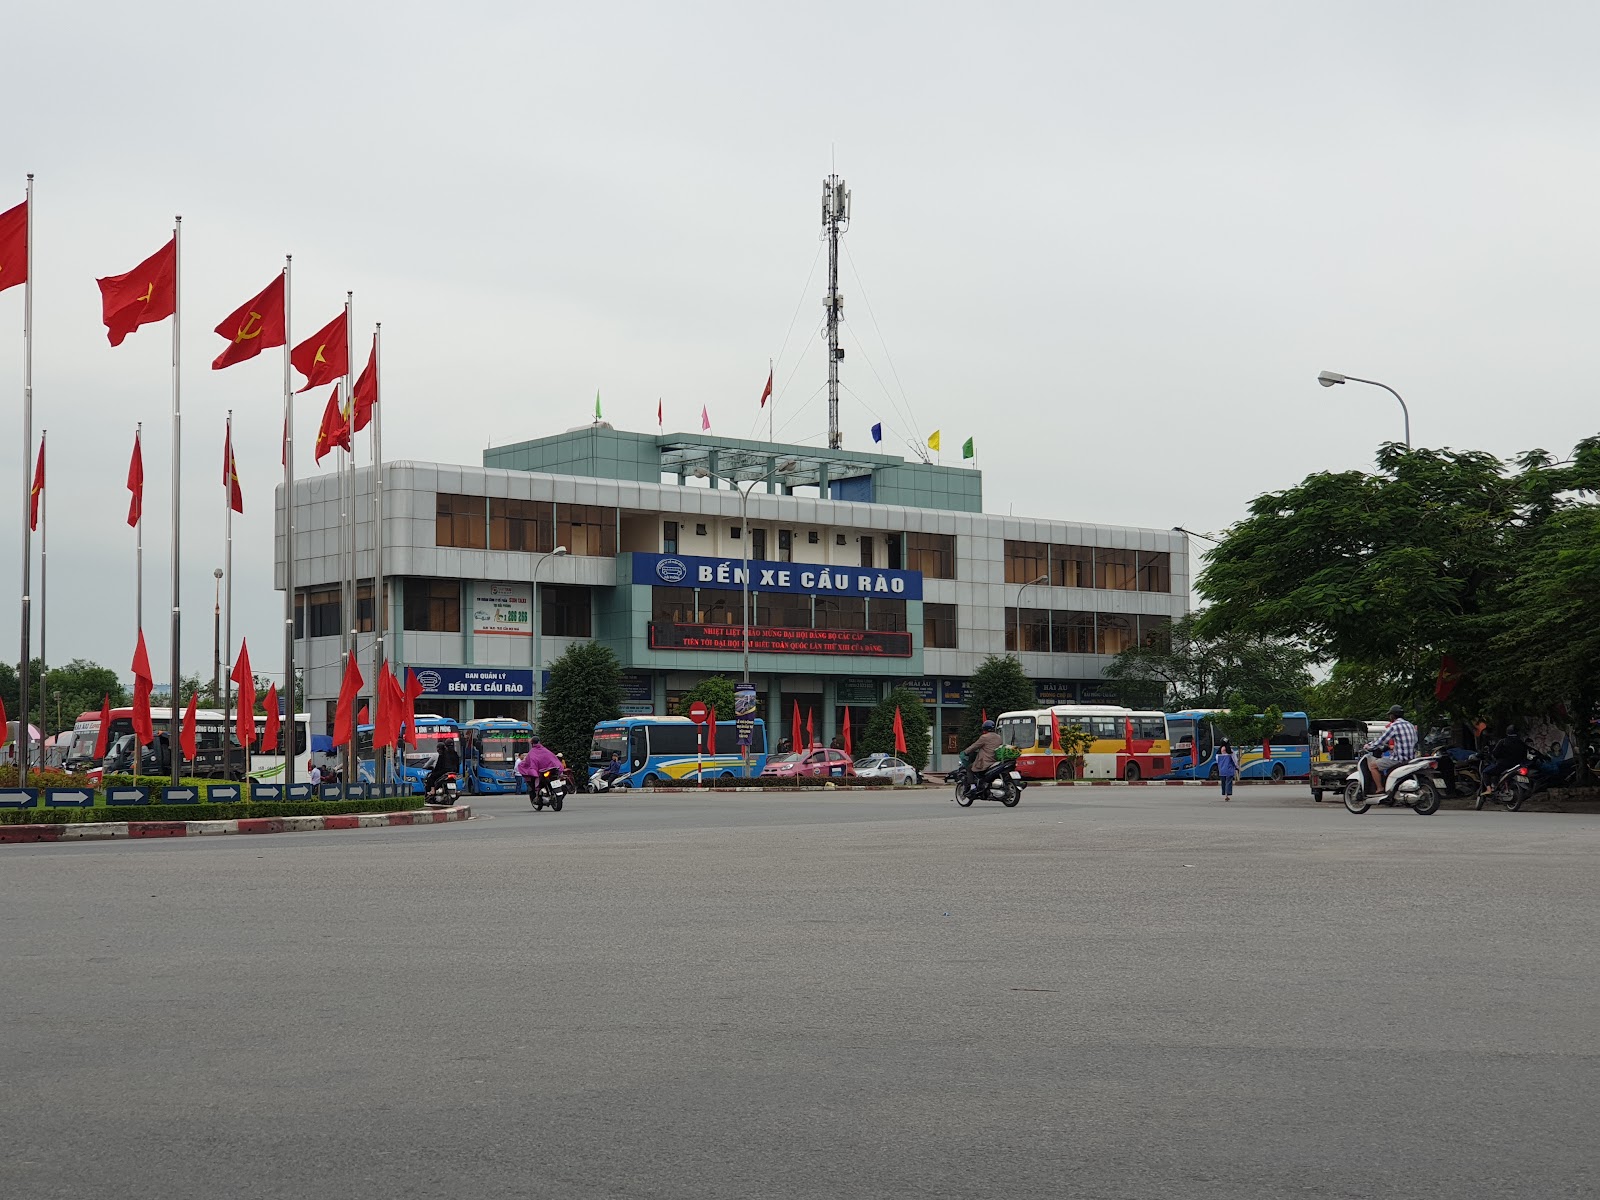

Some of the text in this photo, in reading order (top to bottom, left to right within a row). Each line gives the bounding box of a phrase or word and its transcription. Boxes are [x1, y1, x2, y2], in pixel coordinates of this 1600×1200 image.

[698, 561, 749, 584] BẾN
[759, 569, 791, 586] XE
[800, 567, 849, 590] CẦU
[858, 573, 904, 593] RÀO
[703, 627, 723, 636] NHIỆT
[725, 628, 741, 637] LIỆT
[480, 672, 498, 680] QUẢN
[448, 680, 469, 692] BẾN
[469, 683, 482, 692] XE
[484, 681, 503, 692] CẦU
[504, 682, 523, 693] RÀO
